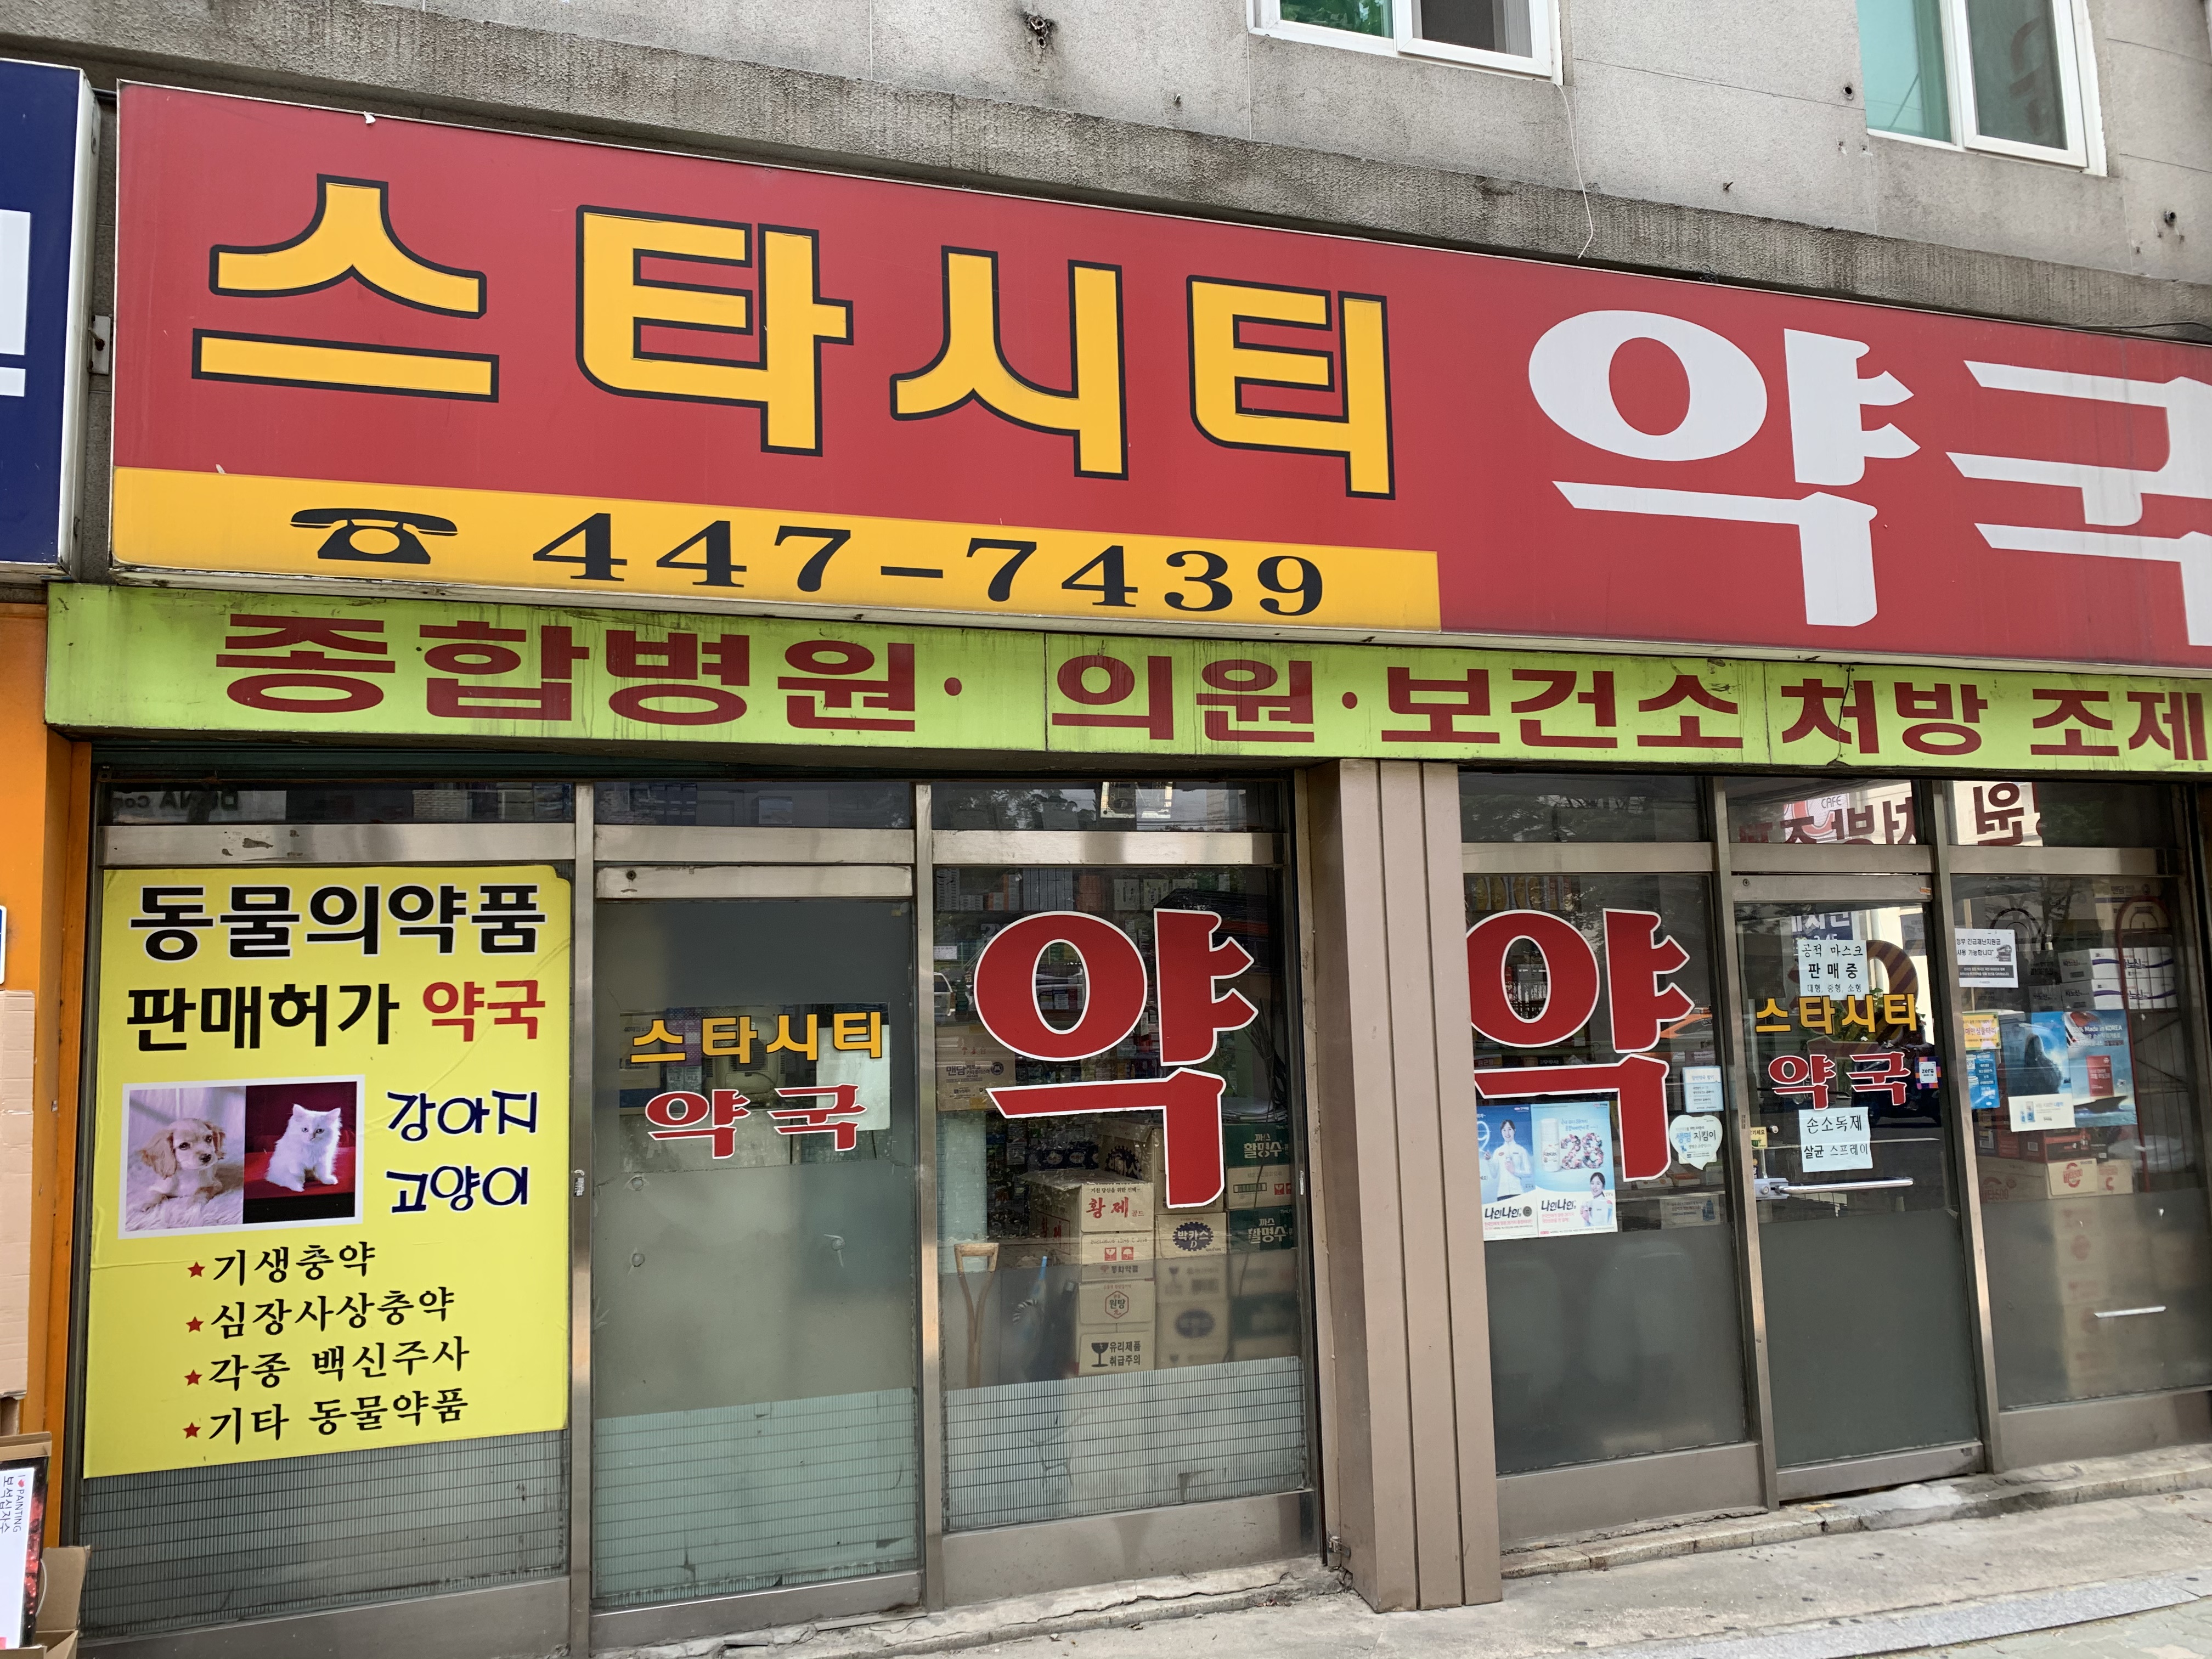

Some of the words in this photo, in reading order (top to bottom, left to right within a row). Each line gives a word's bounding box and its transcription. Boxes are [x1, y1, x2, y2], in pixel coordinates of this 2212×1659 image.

[192, 174, 1395, 499] 스타시티
[1528, 309, 2212, 646] 약국
[532, 510, 1323, 616] 447-7439
[1380, 665, 1743, 748] 보건소
[1781, 678, 1988, 757] 처방
[2030, 687, 2208, 761] 조제
[1821, 795, 1842, 809] CAFE
[129, 883, 546, 962] 동물의약품
[1801, 944, 1822, 958] 공적
[1830, 944, 1864, 957] 마스크
[1848, 984, 1861, 993] 소형
[127, 983, 399, 1052] 판매허가
[422, 980, 546, 1042] 약국
[1754, 992, 1917, 1036] 스타시티
[1965, 1027, 1996, 1036] 매안심울타리
[630, 1011, 882, 1064] 스타시티
[973, 907, 1259, 1209] 약
[1466, 907, 1695, 1182] 약
[387, 1090, 538, 1142] 강아지
[1255, 1133, 1271, 1141] 까스
[1694, 1130, 1716, 1142] 지킴이
[1807, 1115, 1863, 1134] 손소독제
[1560, 1132, 1604, 1170] 28
[1803, 1145, 1824, 1159] 살균
[1830, 1143, 1868, 1156] 스프레이
[385, 1165, 529, 1214] 고양이
[1178, 1229, 1209, 1241] 박카스
[213, 1241, 376, 1287] 기생충약
[211, 1286, 456, 1340] 심장사상충약
[1109, 1299, 1126, 1310] 원탕
[208, 1352, 291, 1392] 각종
[312, 1335, 470, 1383] 백신주사
[1109, 1340, 1141, 1353] 유리제품
[1109, 1354, 1141, 1367] 취급주의
[208, 1403, 290, 1445] 기타
[308, 1387, 469, 1436] 동물약품
[13, 1489, 25, 1533] PAINTING
